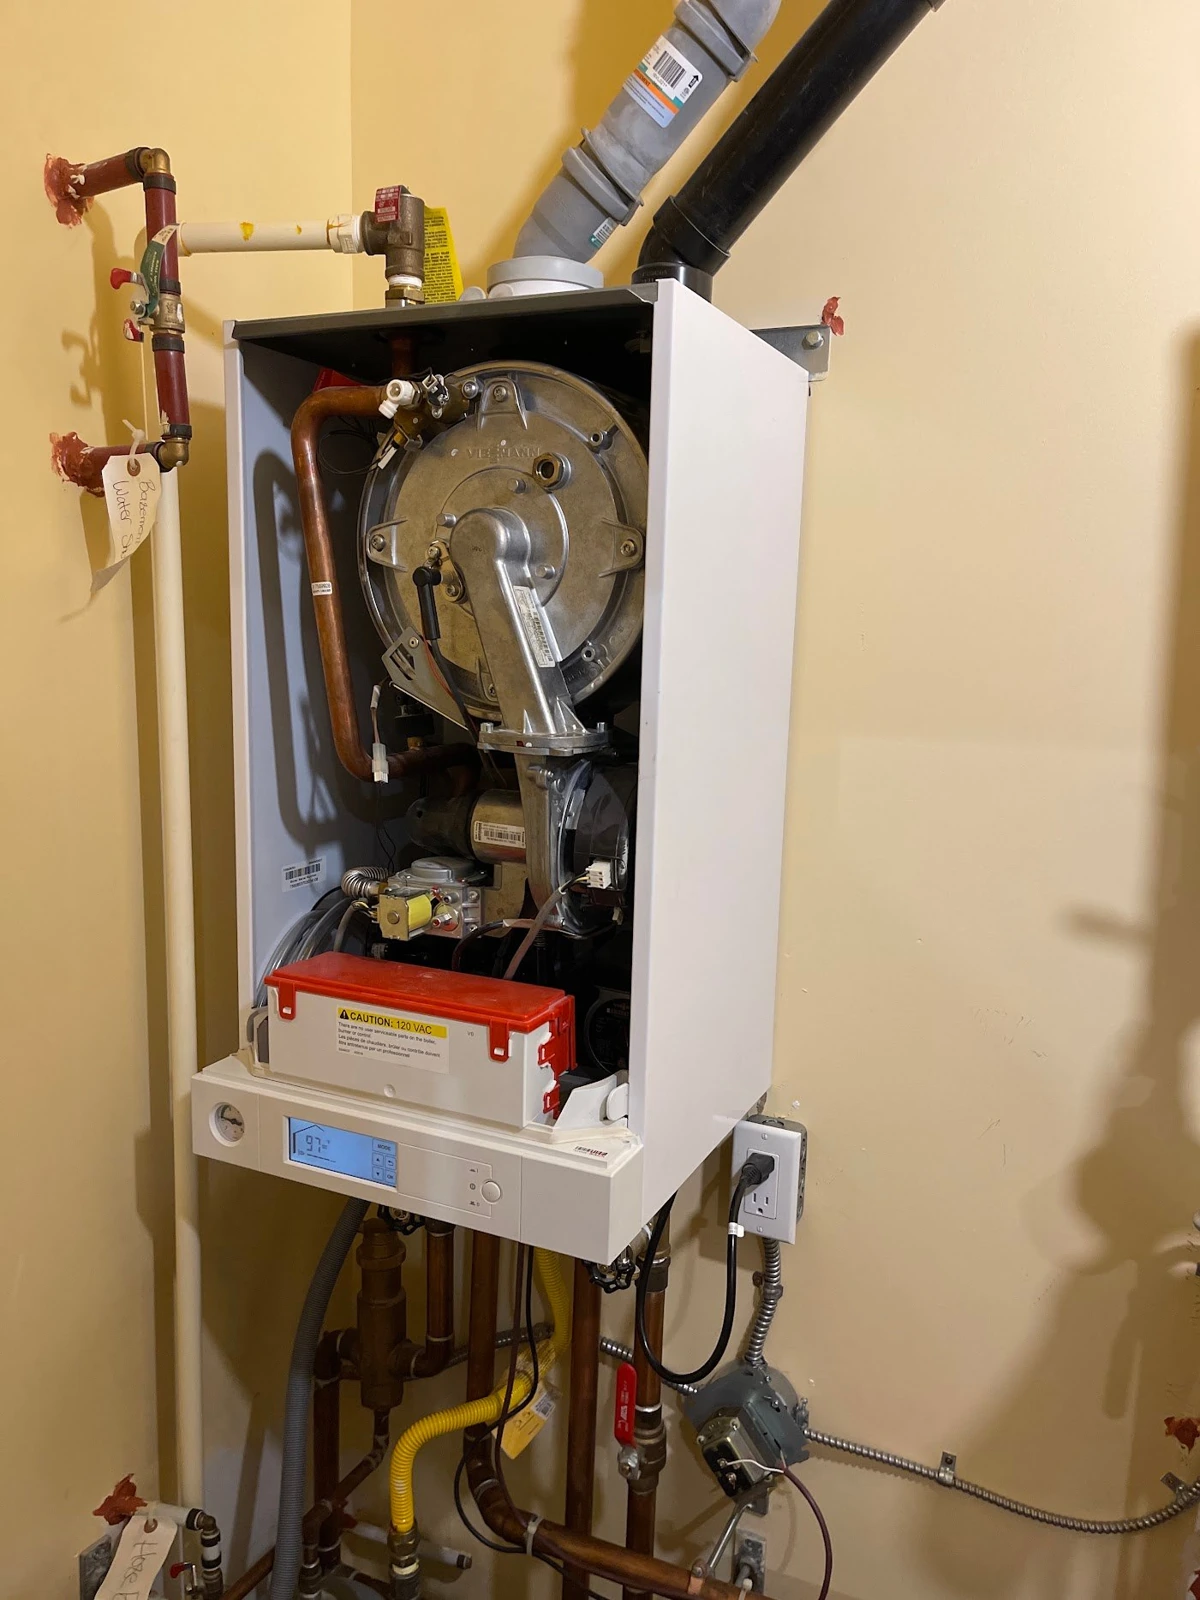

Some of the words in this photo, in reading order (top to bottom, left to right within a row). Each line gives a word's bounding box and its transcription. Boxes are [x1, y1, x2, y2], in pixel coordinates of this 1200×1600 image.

[113, 481, 131, 526] Water
[350, 1012, 393, 1028] CAUTION:
[396, 1020, 411, 1031] 120
[413, 1023, 432, 1035] VAC
